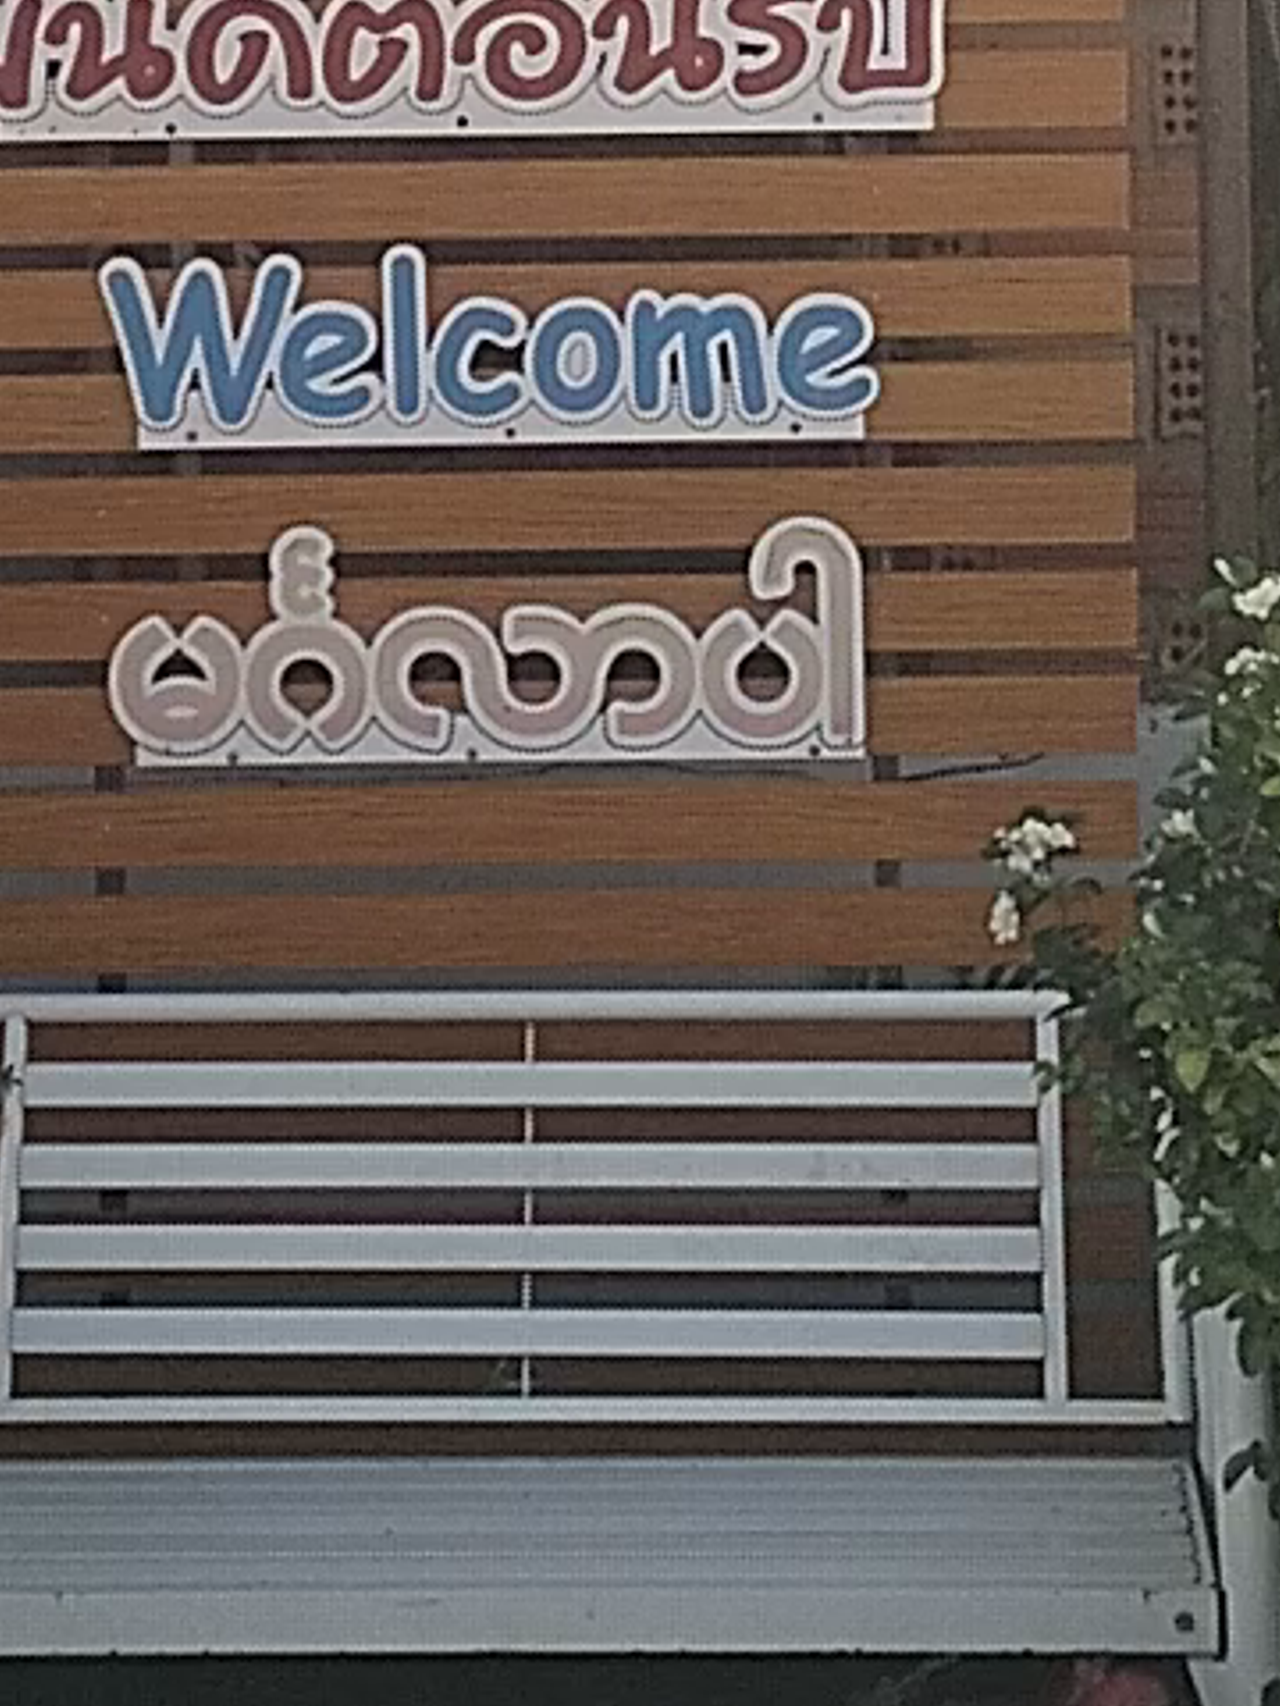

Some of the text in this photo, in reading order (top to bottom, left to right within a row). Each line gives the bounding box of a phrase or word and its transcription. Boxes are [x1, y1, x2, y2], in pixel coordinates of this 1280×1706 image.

[108, 253, 869, 426] Welcome
[115, 523, 863, 749] မင်္ဂလာပါ
